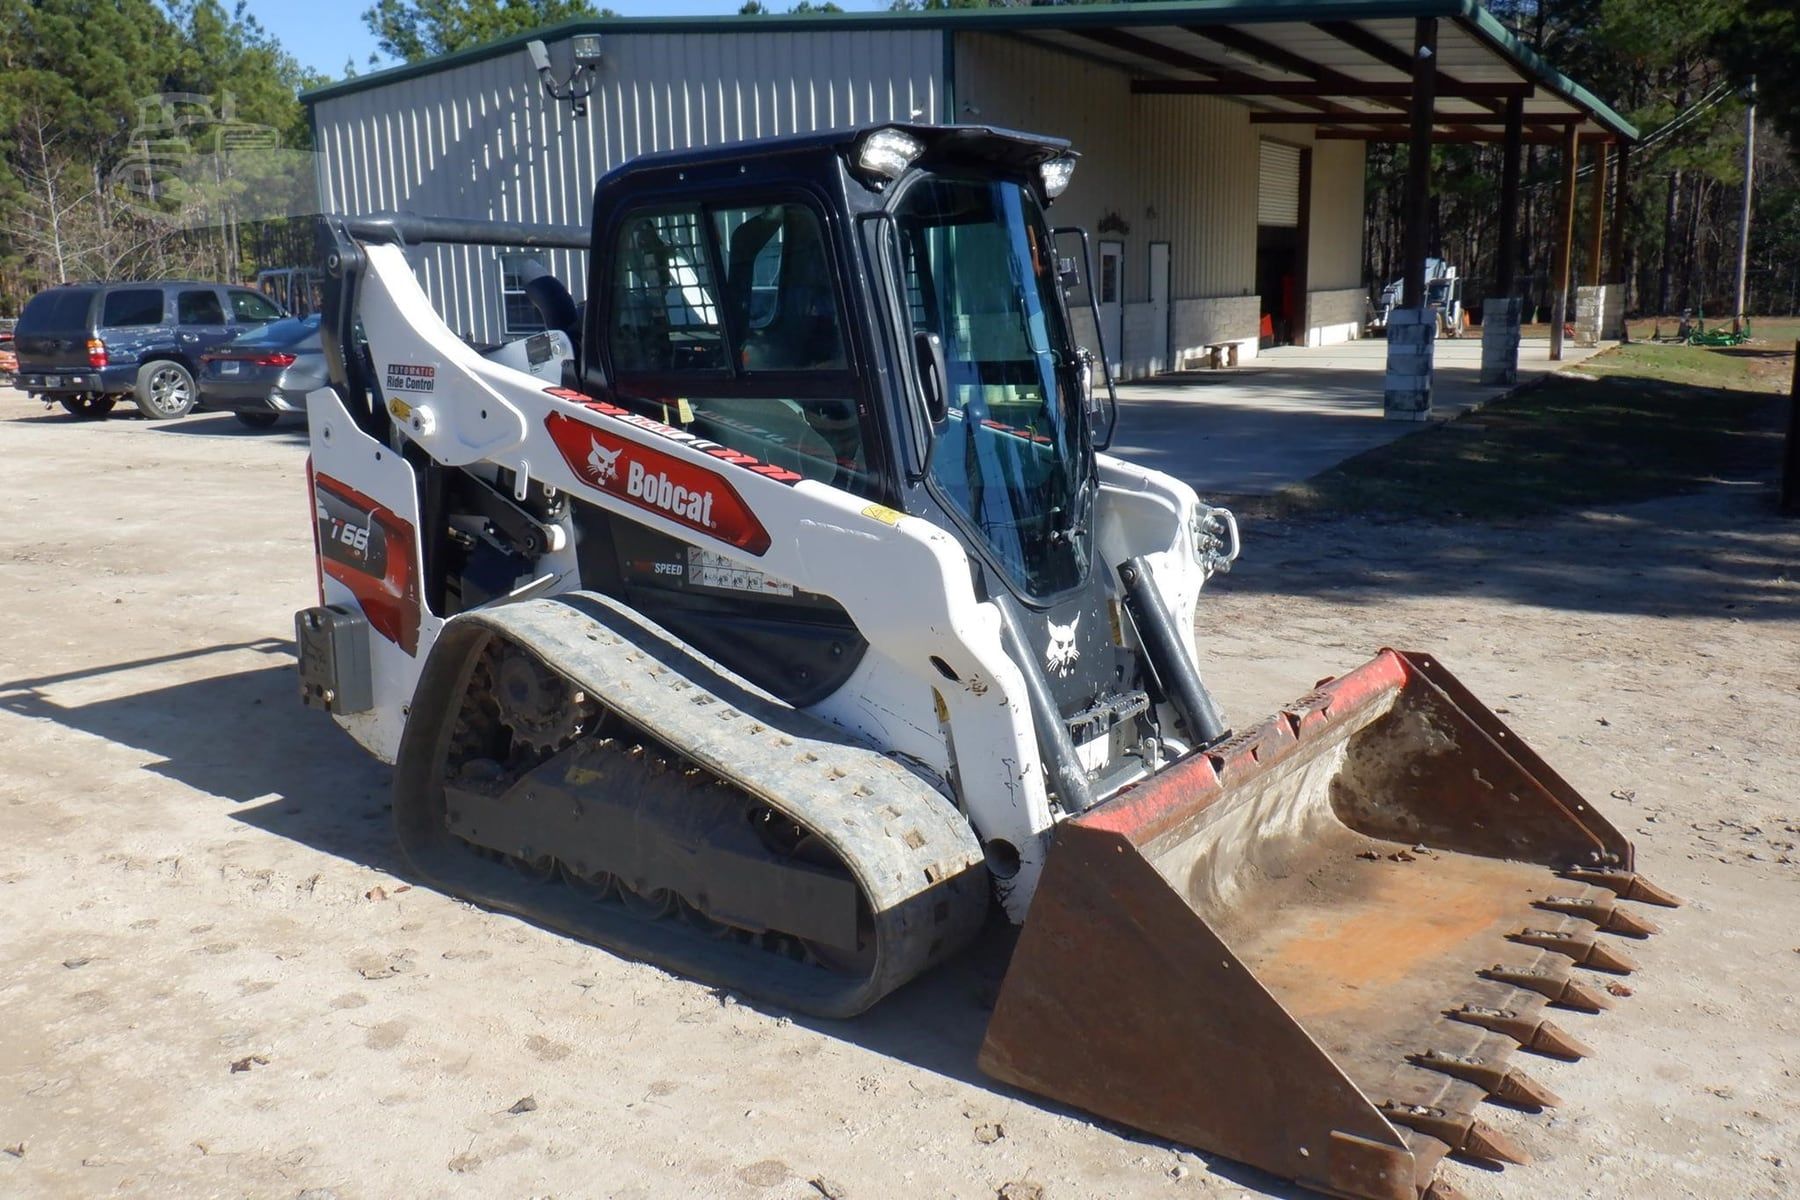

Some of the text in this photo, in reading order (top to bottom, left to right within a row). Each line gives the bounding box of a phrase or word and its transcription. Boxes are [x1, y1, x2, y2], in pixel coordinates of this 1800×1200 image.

[388, 364, 434, 377] AUTOMATIC
[387, 376, 434, 391] Ride Control
[627, 460, 713, 527] Bobcat
[331, 517, 369, 551] T66
[654, 562, 684, 577] SPEED
